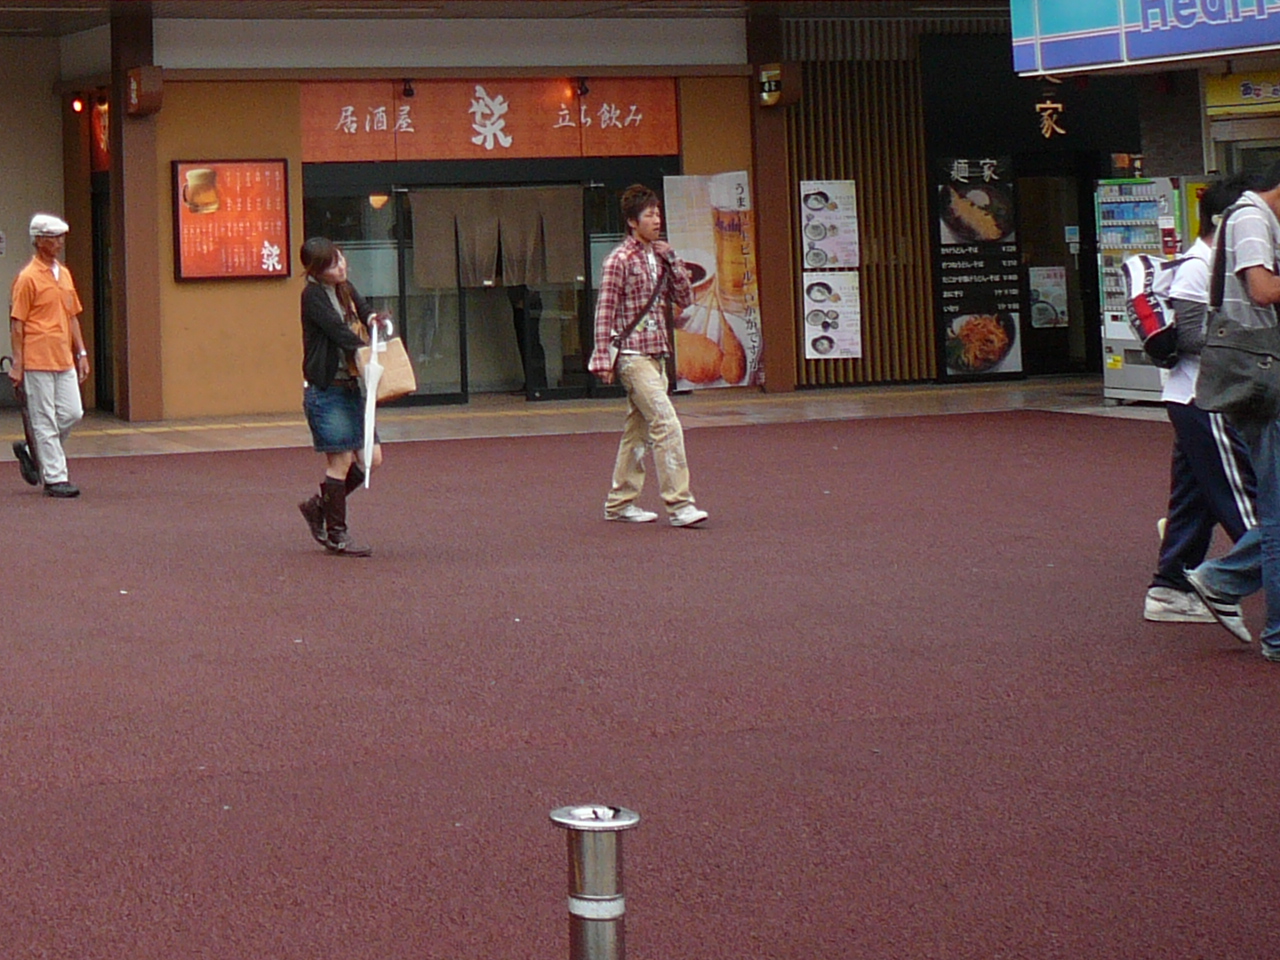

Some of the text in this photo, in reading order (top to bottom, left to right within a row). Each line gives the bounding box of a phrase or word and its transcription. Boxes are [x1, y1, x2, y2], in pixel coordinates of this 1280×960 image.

[334, 105, 415, 134] 居酒屋
[552, 102, 643, 130] 立ち飲み
[950, 158, 1000, 183] 麺家
[1142, 266, 1163, 313] TOMMY
